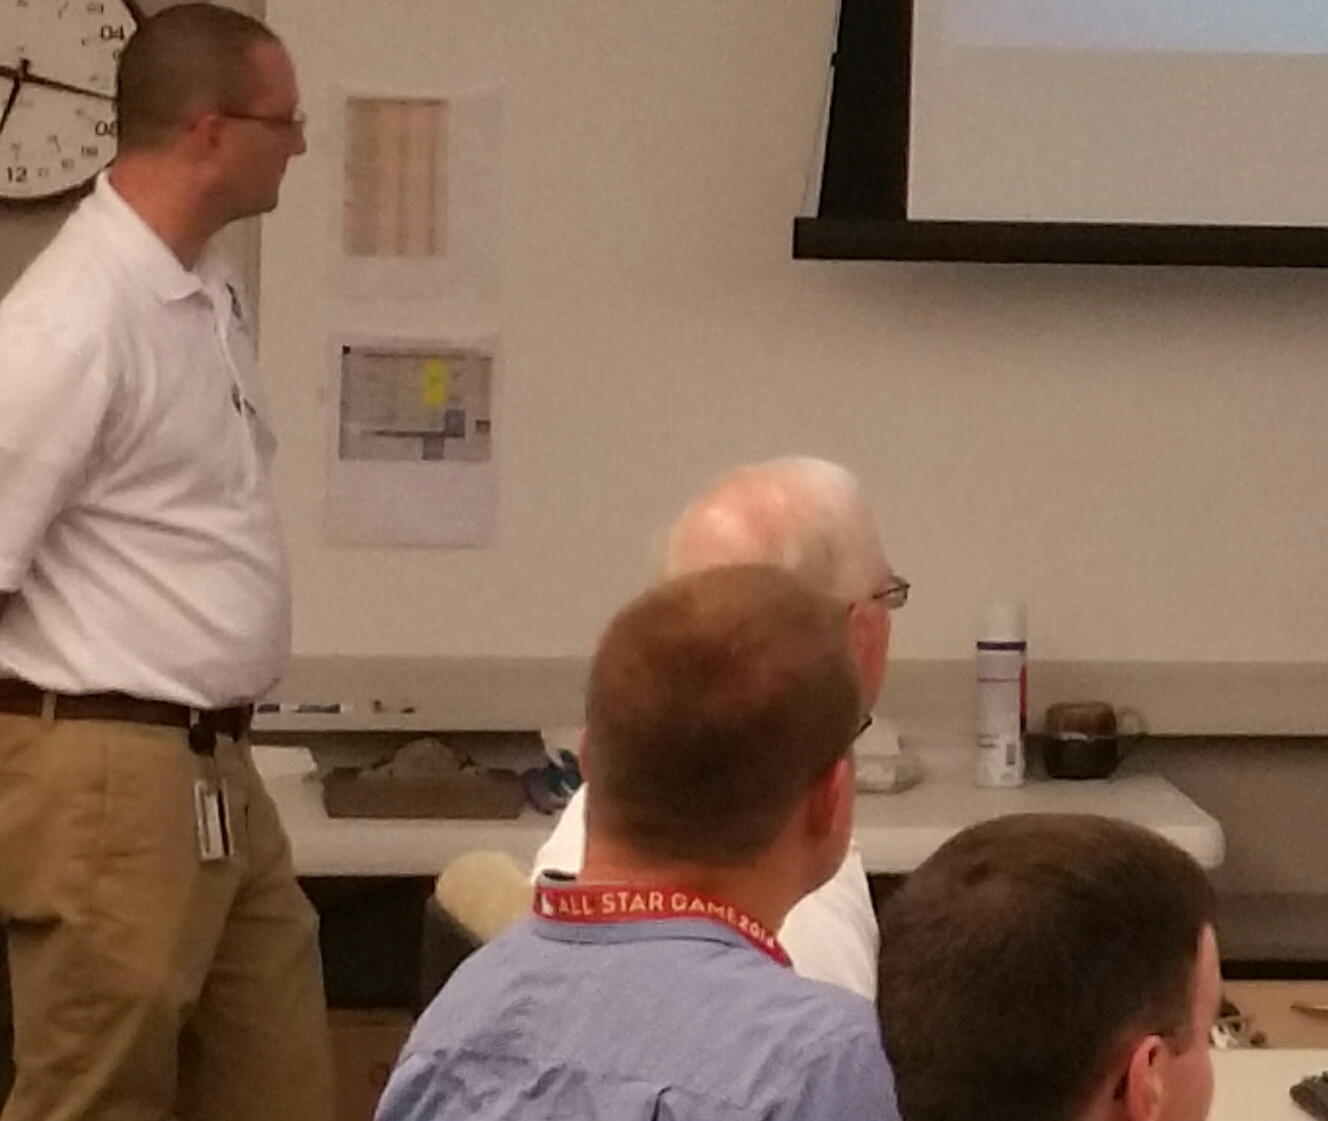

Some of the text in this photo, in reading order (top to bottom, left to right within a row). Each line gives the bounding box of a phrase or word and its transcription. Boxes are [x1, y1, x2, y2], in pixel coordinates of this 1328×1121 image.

[557, 898, 594, 916] ALL
[602, 891, 664, 914] STAR
[671, 894, 735, 925] GAME
